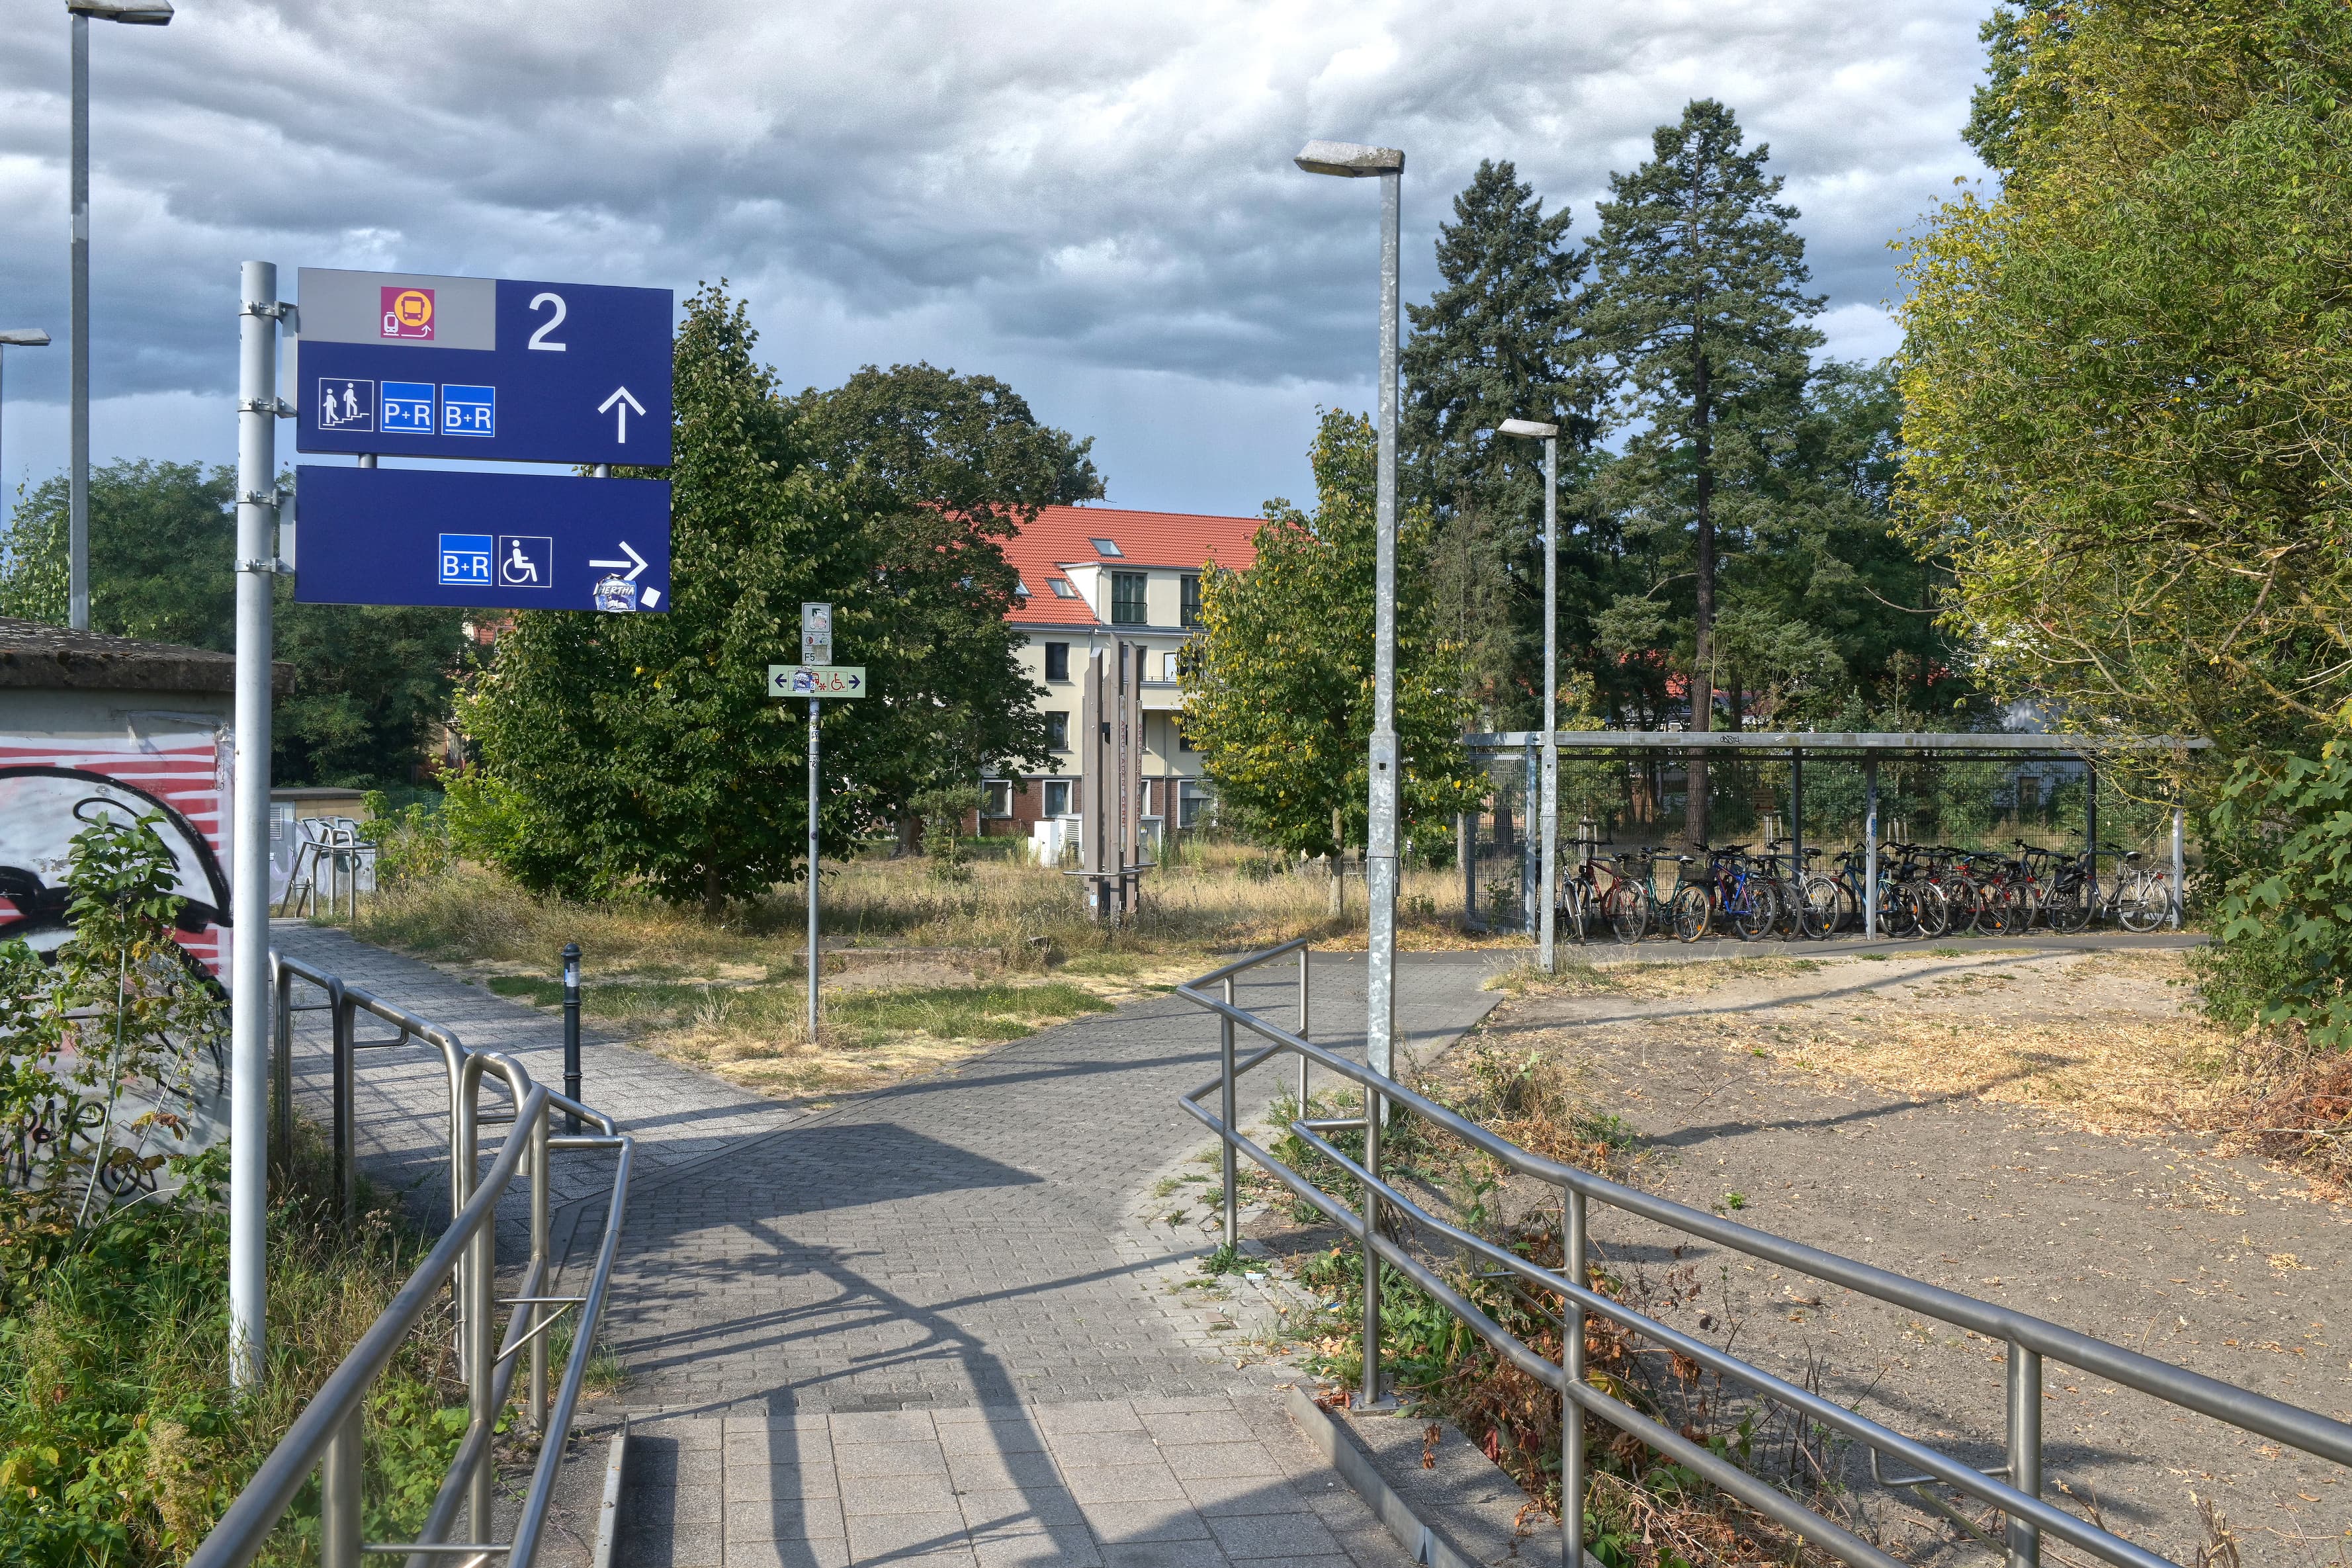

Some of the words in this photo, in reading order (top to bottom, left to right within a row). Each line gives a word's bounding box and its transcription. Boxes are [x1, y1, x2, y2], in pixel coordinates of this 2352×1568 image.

[528, 292, 566, 351] 2
[385, 403, 430, 425] P+R
[446, 406, 491, 429] B+R
[443, 555, 488, 578] B+R
